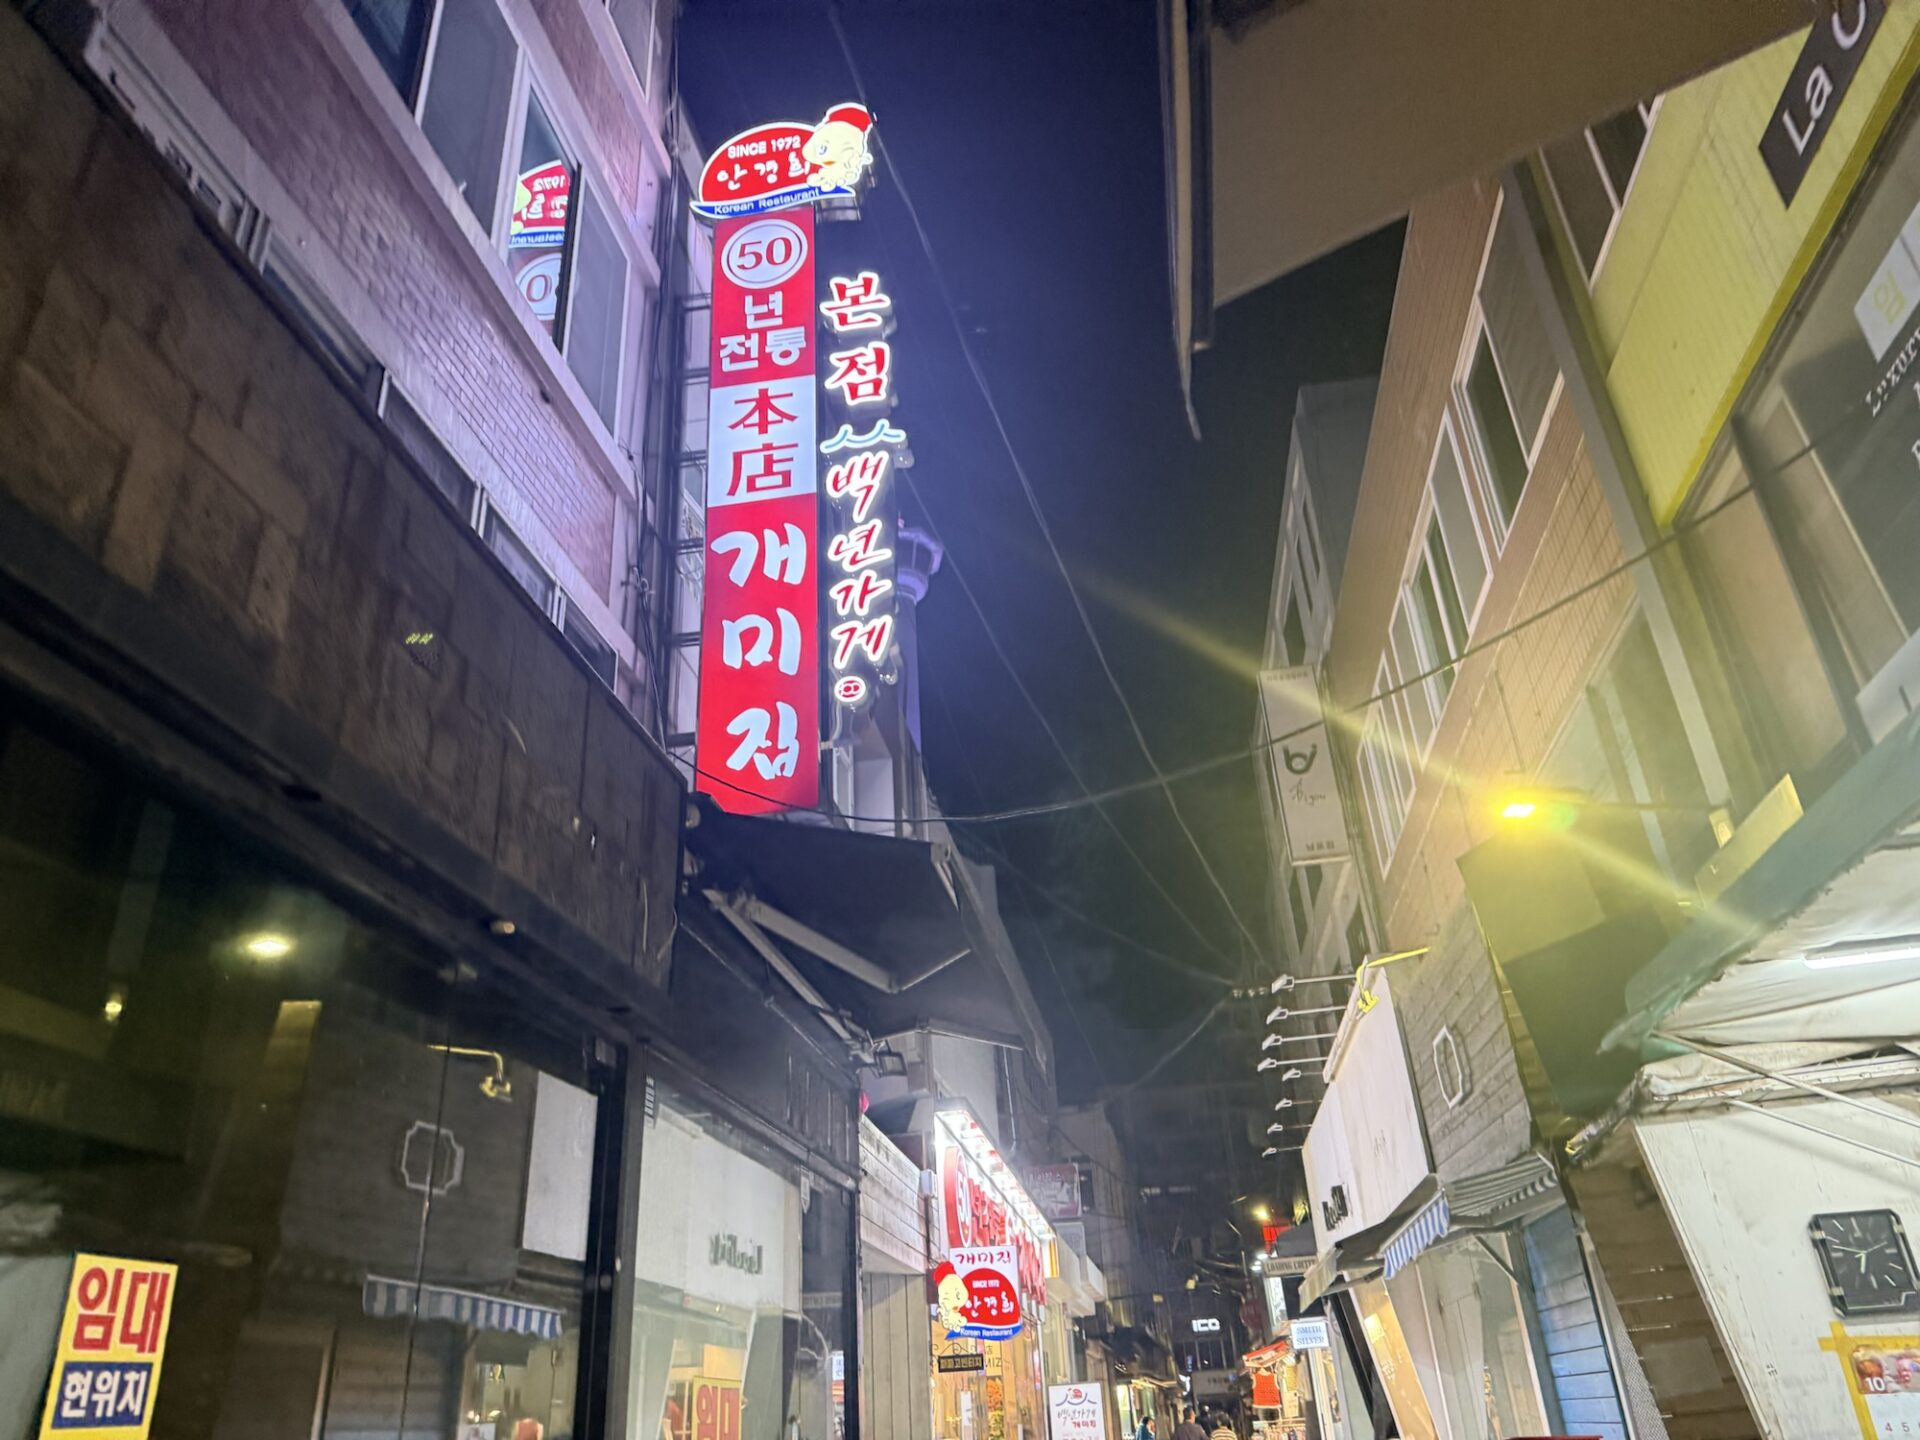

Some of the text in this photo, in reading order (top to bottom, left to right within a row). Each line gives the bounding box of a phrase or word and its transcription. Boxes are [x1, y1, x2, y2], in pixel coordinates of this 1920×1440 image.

[1782, 65, 1833, 156] La
[727, 135, 801, 159] SINCE 1972
[714, 188, 820, 215] Korean Restaurant
[737, 237, 793, 270] 50
[744, 291, 783, 329] 년
[719, 326, 806, 372] 전통
[820, 271, 892, 405] 본점
[727, 388, 799, 497] 本店
[826, 451, 893, 670] 백년가게
[710, 522, 808, 781] 개미집
[955, 1251, 1011, 1265] 개미집
[73, 1267, 170, 1353] 임대
[965, 1291, 1014, 1318] 안경희
[960, 1328, 1013, 1336] Korean Restaurant
[1296, 1325, 1322, 1335] SMITH
[1296, 1336, 1324, 1346] SILVER
[61, 1370, 147, 1418] 현위치
[1865, 1377, 1885, 1391] 10
